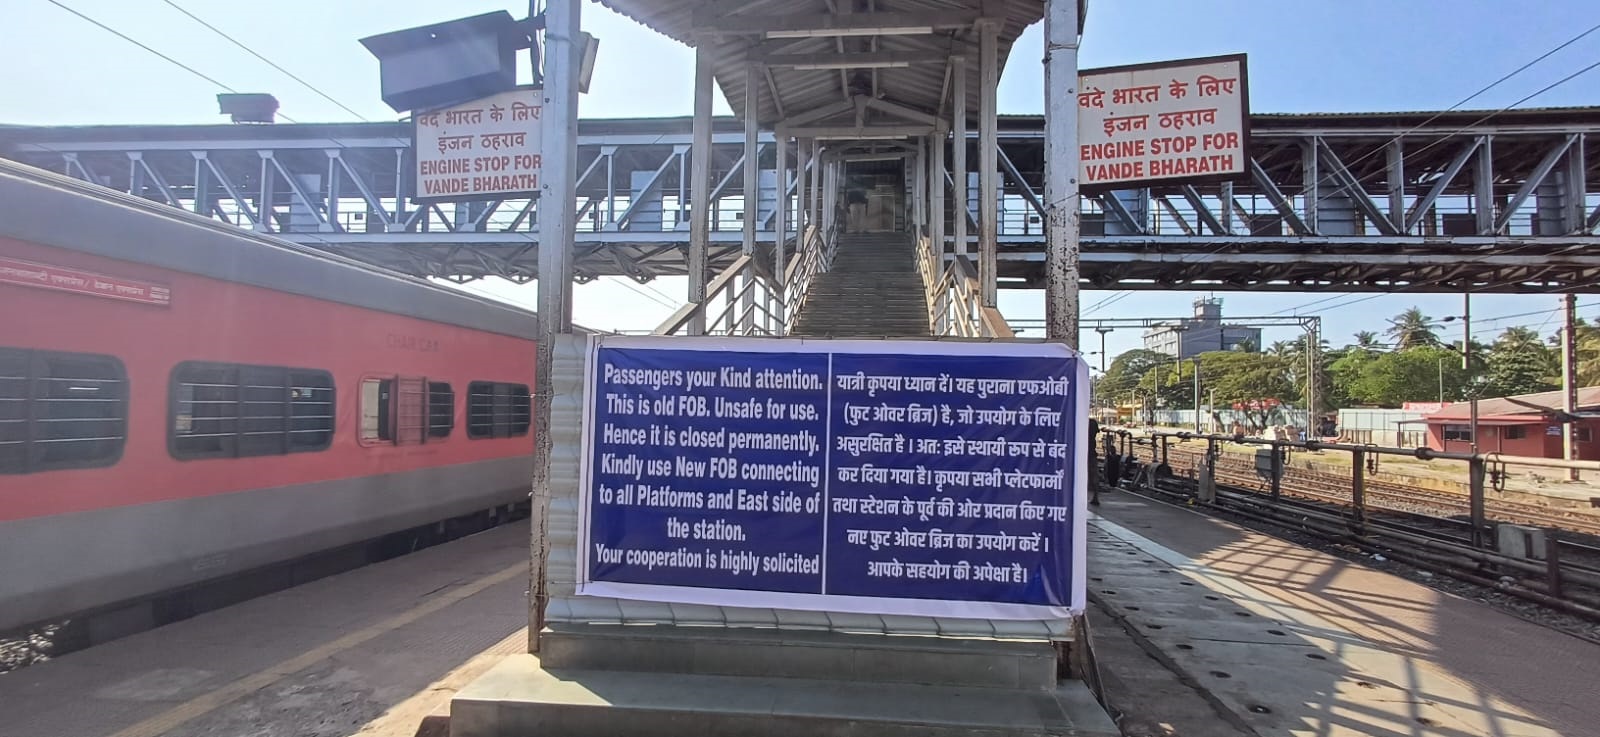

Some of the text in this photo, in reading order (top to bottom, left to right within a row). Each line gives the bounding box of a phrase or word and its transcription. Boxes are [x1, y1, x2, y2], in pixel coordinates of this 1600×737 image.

[1078, 75, 1236, 108] वंदे भारत के लिए
[446, 110, 483, 125] भारत
[490, 104, 504, 122] के
[512, 102, 542, 121] लिए
[1103, 109, 1217, 137] इंजन ठहराव
[438, 131, 527, 154] इंजन ठहराव
[1081, 132, 1238, 160] ENGINE STOP FOR
[420, 155, 542, 175] ENGINE STOP FOR
[1086, 155, 1233, 181] VANDE BHARATH
[424, 174, 536, 194] VANDE BHARATH
[604, 363, 823, 391] Passengers your Kind attention.
[837, 371, 864, 391] यात्री
[868, 375, 901, 397] कृपया
[904, 376, 936, 392] ध्यान
[956, 377, 975, 394] यह
[977, 378, 1014, 398] पुराना
[1017, 376, 1068, 396] एफओबी
[606, 393, 818, 420] This is old FOB. Unsafe for use.
[844, 402, 1061, 427] (फुट ओवर ब्रिज) है, जो उपयोग के लिए
[604, 424, 819, 456] Hence it is closed permanently.
[837, 433, 892, 456] असुरक्षित
[895, 434, 904, 453] है
[943, 436, 965, 457] इसे
[968, 437, 1005, 456] स्थायी
[1008, 442, 1030, 457] रूप
[1033, 438, 1045, 458] से
[1048, 440, 1067, 459] बंद
[602, 453, 819, 487] Kindly use New FOB connecting
[838, 467, 858, 482] कर
[861, 464, 887, 483] दिया
[890, 468, 914, 484] गया
[935, 470, 969, 491] कृपया
[972, 468, 1001, 487] सभी
[600, 484, 820, 513] to all Platforms and East side of
[833, 495, 1066, 521] तथा स्टेशन के पूर्व की ओर प्रदान किए गए
[667, 517, 746, 541] the station.
[847, 529, 867, 545] नए
[870, 529, 890, 549] फुट
[894, 527, 926, 547] ओवर
[929, 528, 953, 549] ब्रिज
[957, 534, 973, 549] का
[976, 531, 1016, 551] उपयोग
[1019, 533, 1041, 552] करें
[596, 544, 819, 576] Your cooperation is highly solicited
[868, 558, 903, 577] आपके
[906, 560, 950, 579] सहयोग
[953, 561, 970, 580] की
[973, 562, 1009, 582] अपेक्षा
